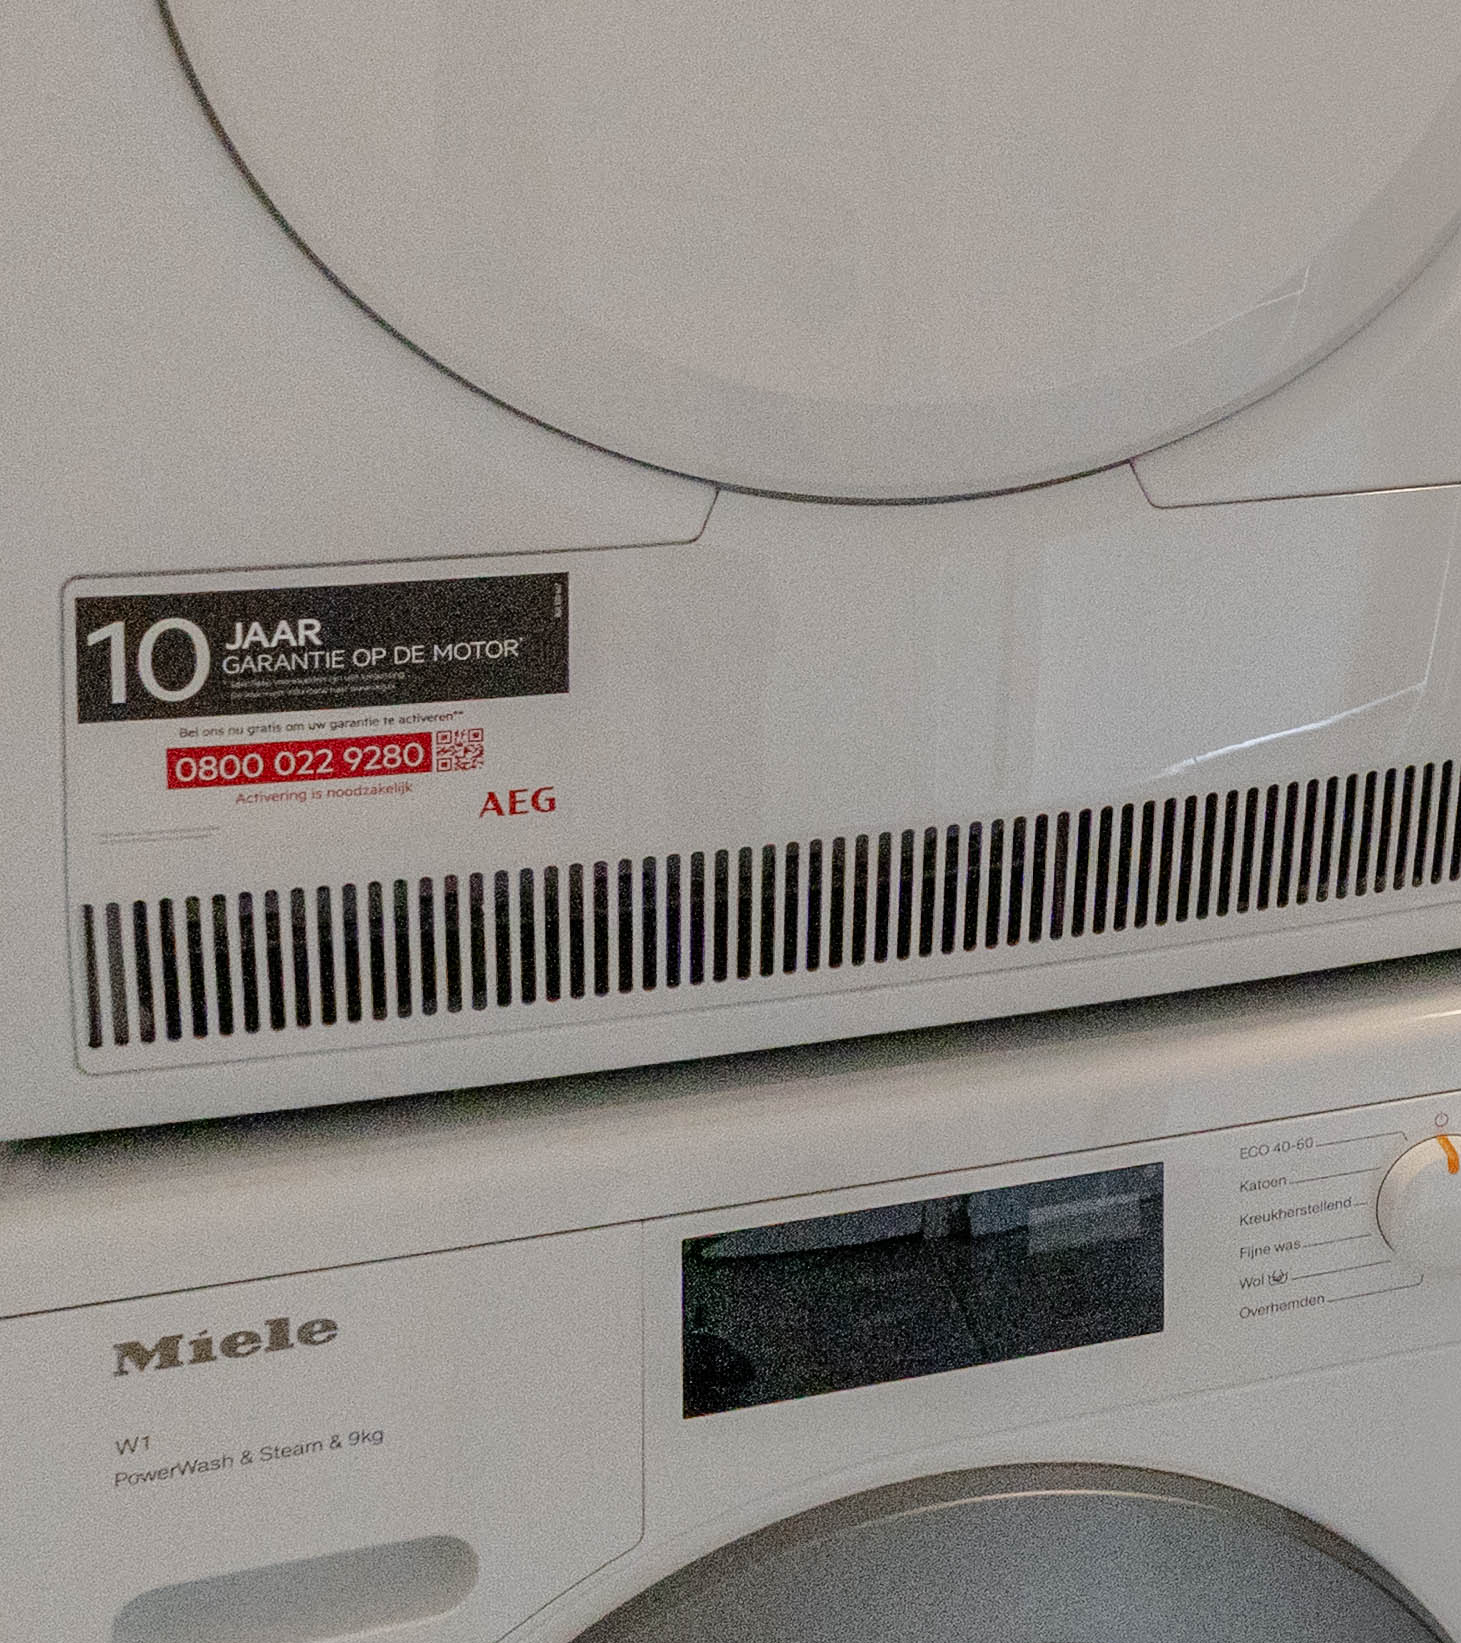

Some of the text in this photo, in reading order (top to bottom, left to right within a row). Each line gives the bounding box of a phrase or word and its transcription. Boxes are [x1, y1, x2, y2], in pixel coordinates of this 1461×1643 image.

[225, 618, 323, 651] JAAR
[87, 617, 211, 704] 10
[222, 649, 345, 674] GARANTIE
[353, 647, 387, 667] OP
[394, 645, 425, 665] DE
[180, 726, 200, 738] Bel
[203, 726, 224, 737] ons
[228, 726, 244, 736] nu
[247, 722, 283, 738] gratis
[287, 722, 305, 732] om
[309, 721, 326, 732] uw
[330, 716, 379, 732] garantie
[384, 715, 395, 727] te
[175, 741, 424, 782] 0800 022 9280
[236, 782, 412, 807] Activering is noodzakelijk
[480, 786, 556, 819] AEG
[1240, 1144, 1270, 1159] ECO
[1240, 1177, 1287, 1192] Katoen
[1240, 1197, 1352, 1226] Kreukherstellend
[1240, 1241, 1301, 1259] Fijne was
[1240, 1274, 1264, 1290] Wol
[1240, 1294, 1325, 1320] Overhemden
[113, 1317, 338, 1377] Miele
[114, 1429, 384, 1487] PowerWash & Steam & 9kg
[116, 1435, 150, 1455] W1
